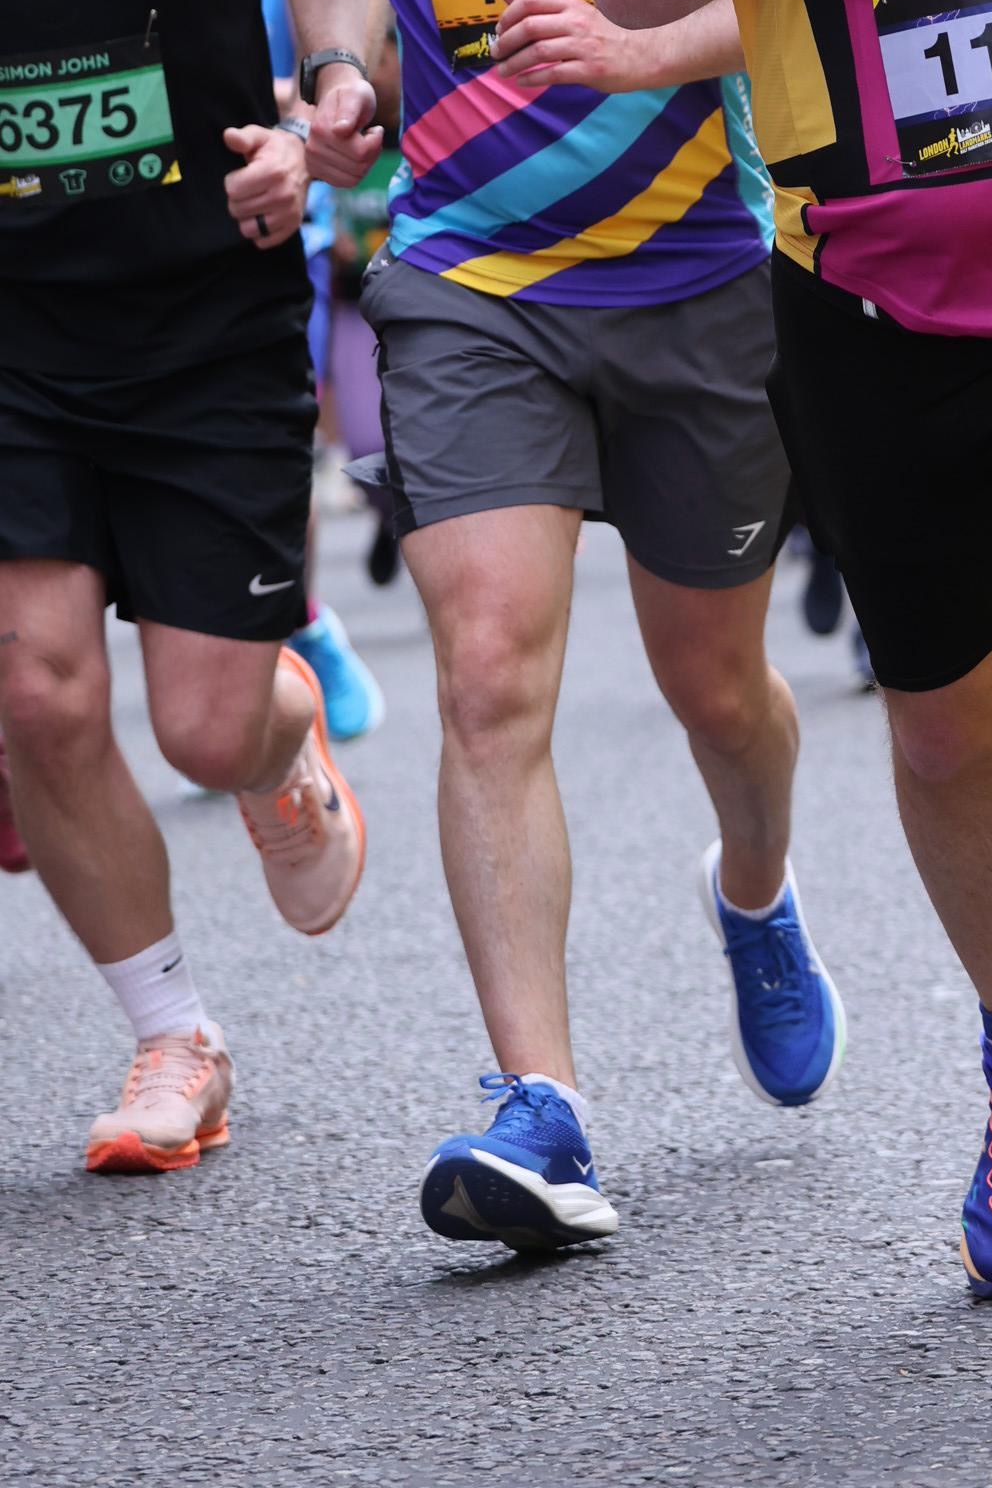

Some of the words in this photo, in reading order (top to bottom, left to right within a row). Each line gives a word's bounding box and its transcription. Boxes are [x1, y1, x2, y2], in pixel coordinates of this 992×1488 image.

[58, 53, 110, 75] JOHN
[0, 86, 137, 152] 6375
[918, 137, 950, 161] LONDON
